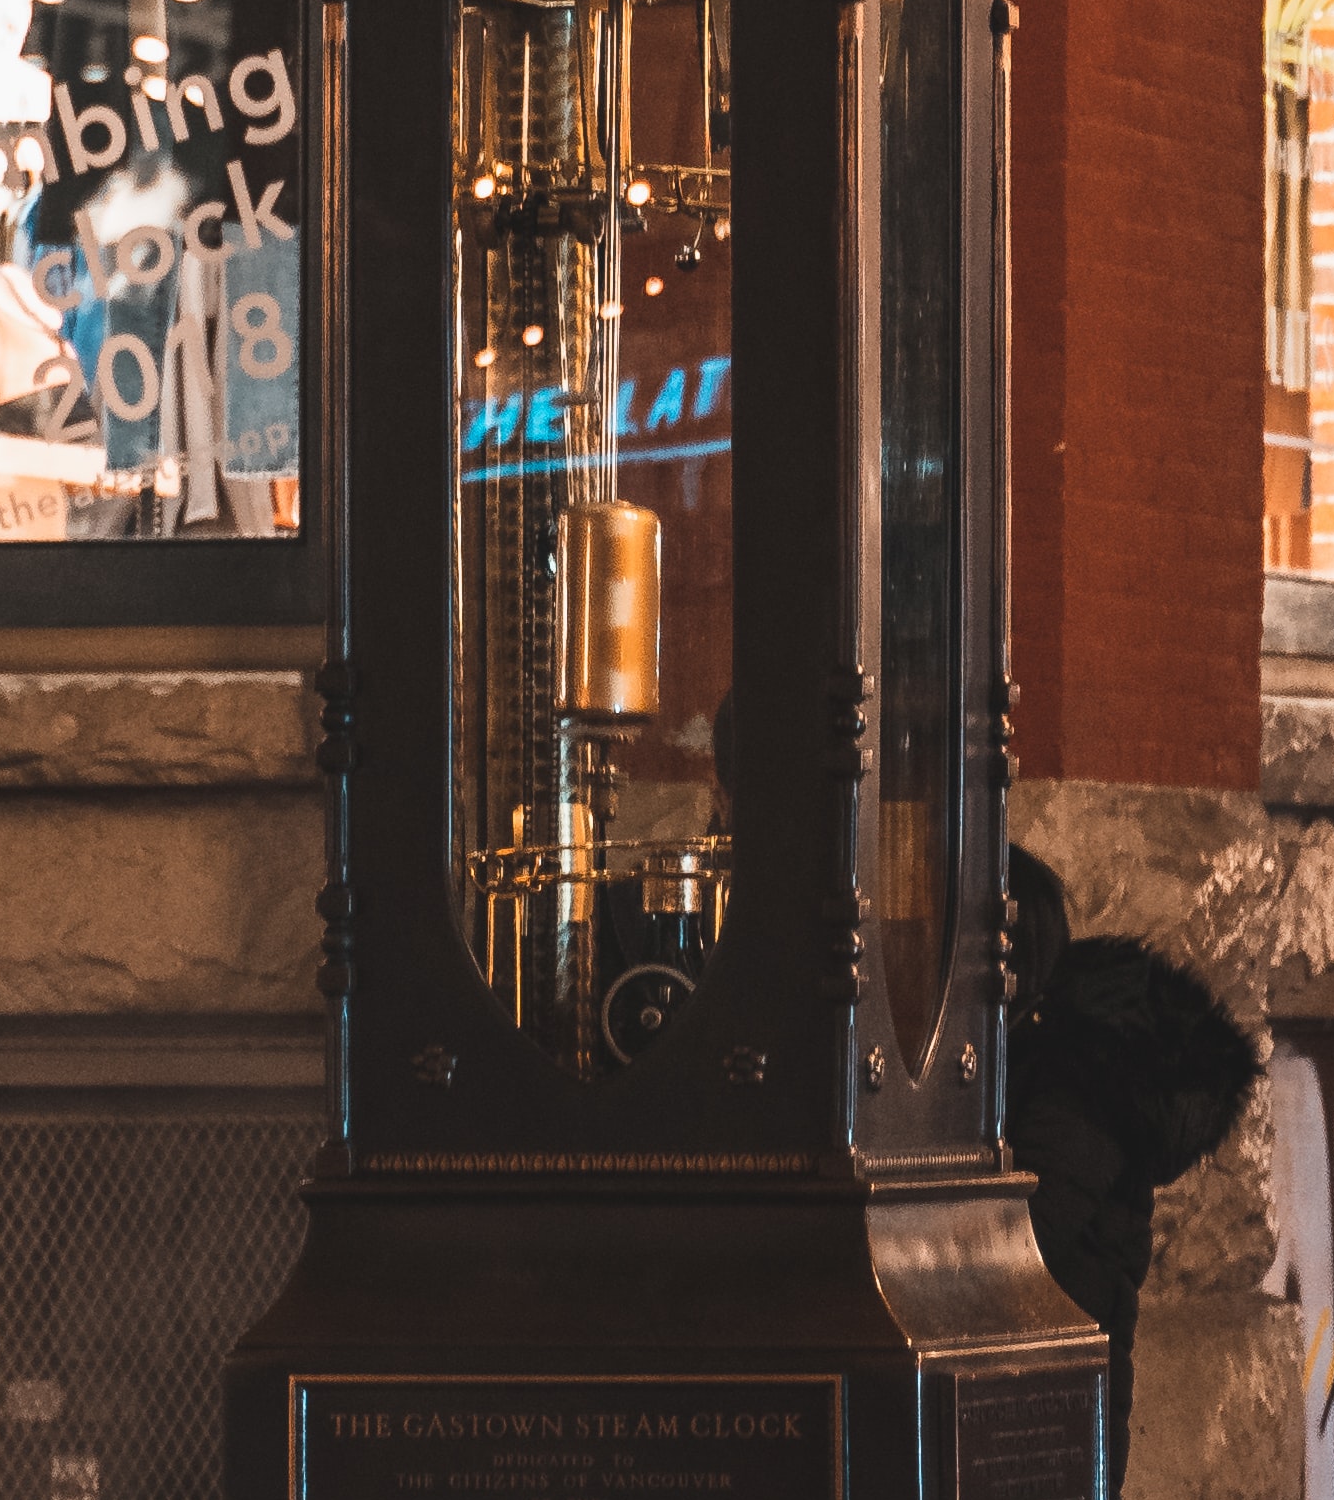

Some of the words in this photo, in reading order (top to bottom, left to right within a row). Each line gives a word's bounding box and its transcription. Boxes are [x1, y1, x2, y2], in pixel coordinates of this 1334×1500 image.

[31, 158, 295, 311] clock
[32, 292, 295, 443] 2018
[329, 1412, 392, 1440] THE
[401, 1412, 564, 1440] GASTOWN
[575, 1412, 680, 1440] STEAM
[688, 1412, 803, 1440] CLOCK
[492, 1452, 596, 1468] DEDICATED
[612, 1452, 636, 1468] TO
[395, 1472, 435, 1489] THE
[447, 1472, 551, 1489] CITIZENS
[562, 1472, 589, 1489] OF
[601, 1472, 733, 1489] VANCOUVER
